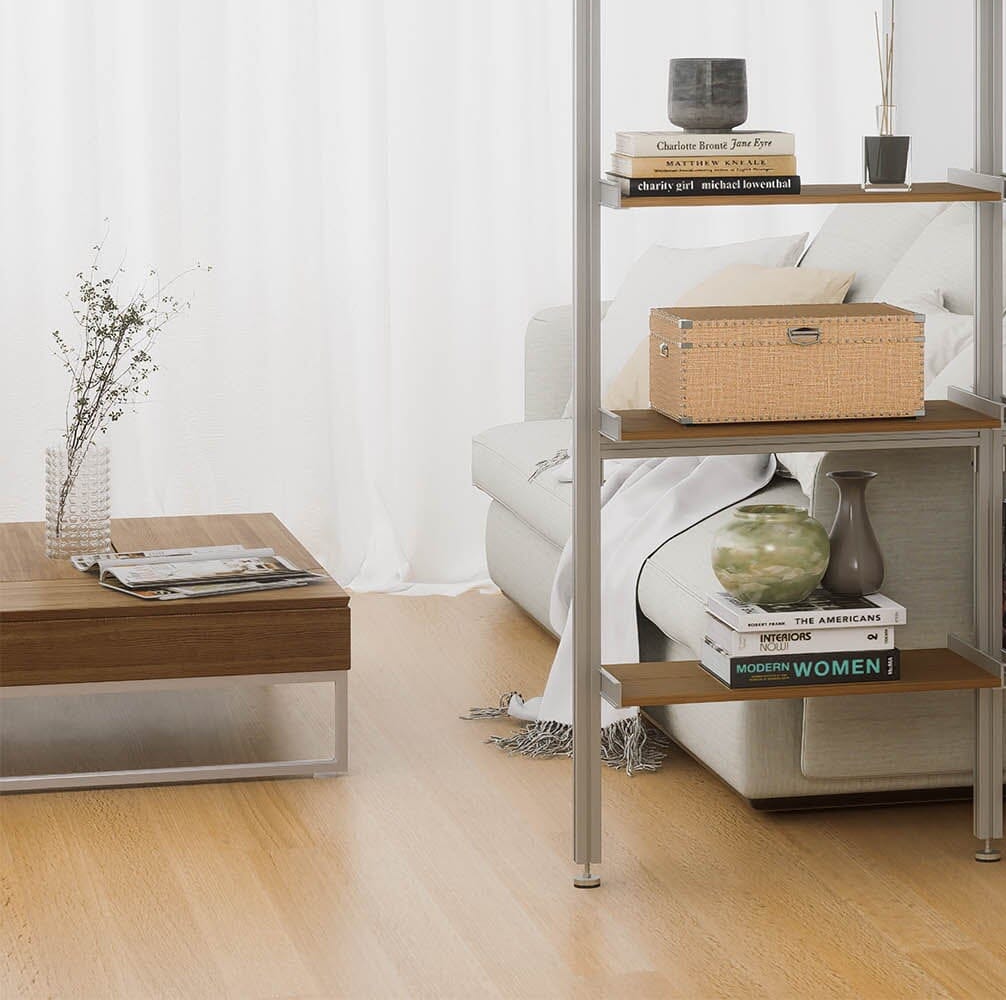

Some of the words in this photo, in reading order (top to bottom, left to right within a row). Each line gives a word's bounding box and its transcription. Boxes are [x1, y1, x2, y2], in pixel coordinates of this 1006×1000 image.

[656, 141, 697, 151] Charlotte
[730, 138, 752, 150] Jane
[753, 138, 773, 148] Eyre
[666, 159, 720, 167] MATTHEW
[638, 180, 673, 193] charity
[676, 179, 694, 192] girl
[701, 179, 741, 189] michael
[743, 177, 791, 188] lowenthal
[795, 616, 815, 625] THE
[818, 614, 881, 624] AMERICANS
[760, 632, 812, 642] INTERIORS
[760, 642, 789, 652] NOW!
[736, 663, 791, 674] MODERN
[793, 658, 881, 678] WOMEN
